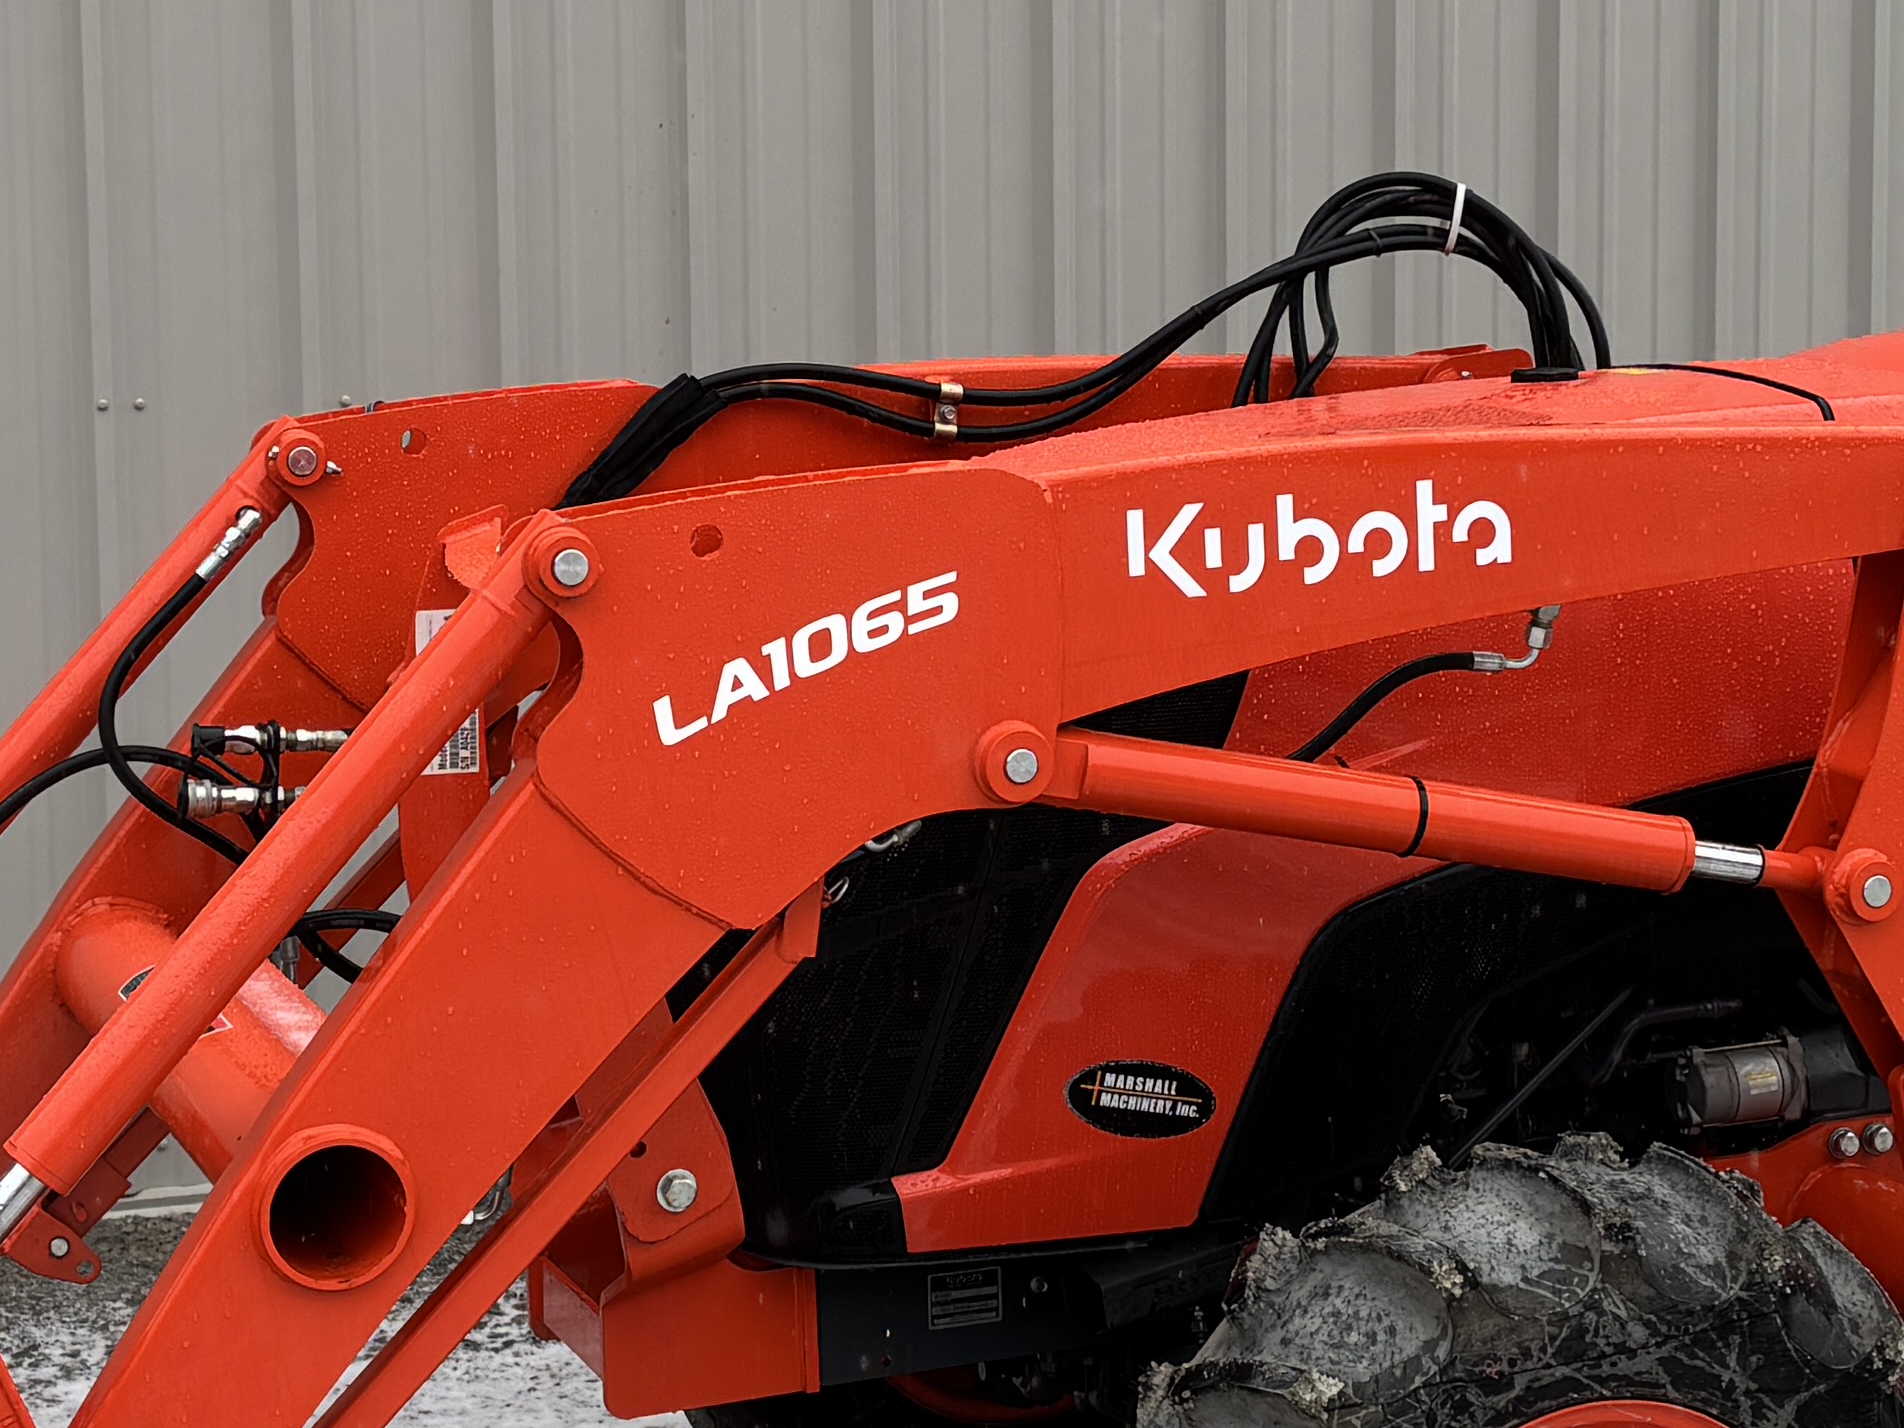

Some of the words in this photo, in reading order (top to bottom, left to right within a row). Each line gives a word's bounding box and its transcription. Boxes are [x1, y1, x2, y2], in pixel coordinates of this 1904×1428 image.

[1126, 477, 1514, 599] Kubota
[652, 570, 961, 747] LA1065
[1099, 1092, 1173, 1116] MACHINERY,
[1175, 1101, 1200, 1118] Inc.
[1103, 1072, 1178, 1095] MARSHALL
